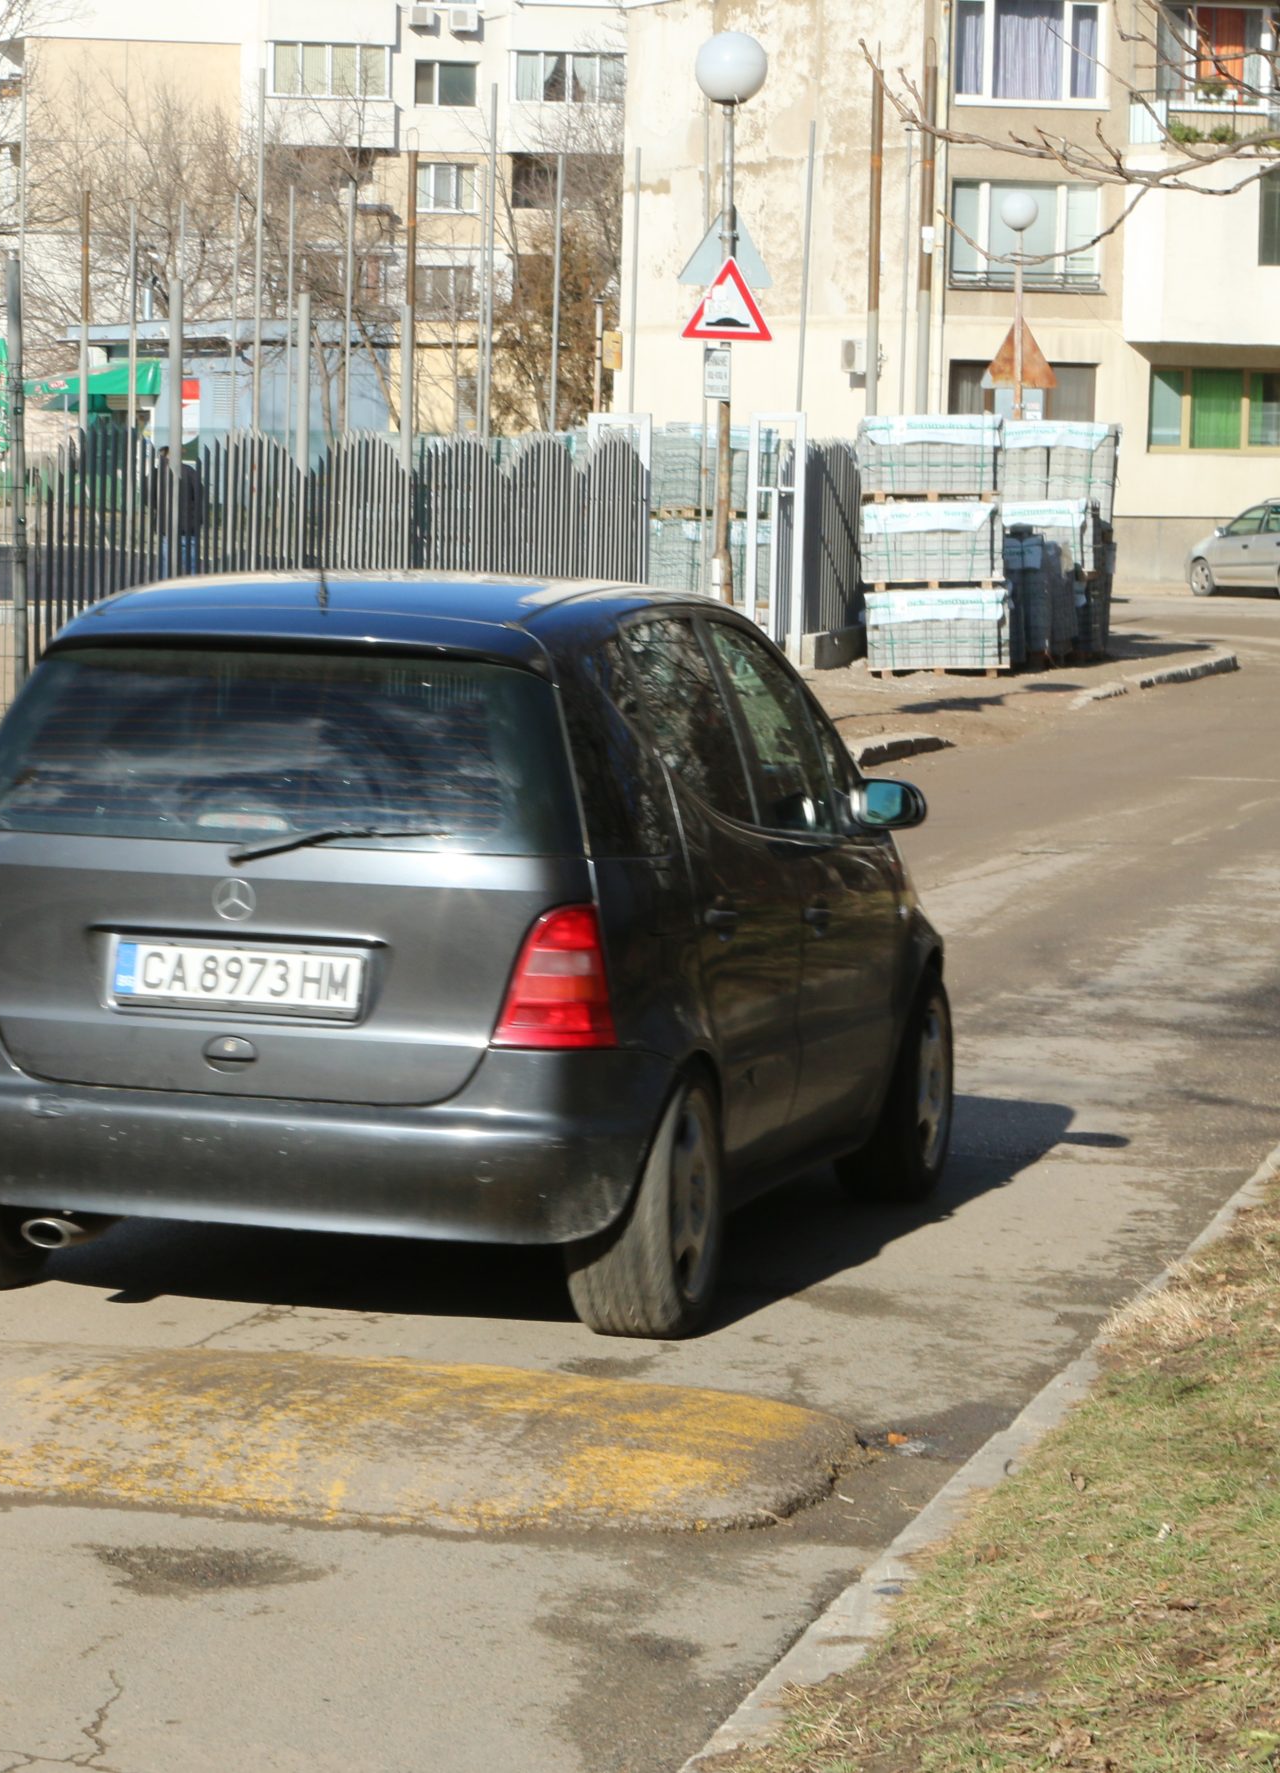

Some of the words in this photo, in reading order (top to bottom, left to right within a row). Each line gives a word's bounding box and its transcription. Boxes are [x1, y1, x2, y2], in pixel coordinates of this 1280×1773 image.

[141, 951, 188, 992] CA
[199, 955, 291, 997] 8973
[300, 960, 350, 1002] HM
